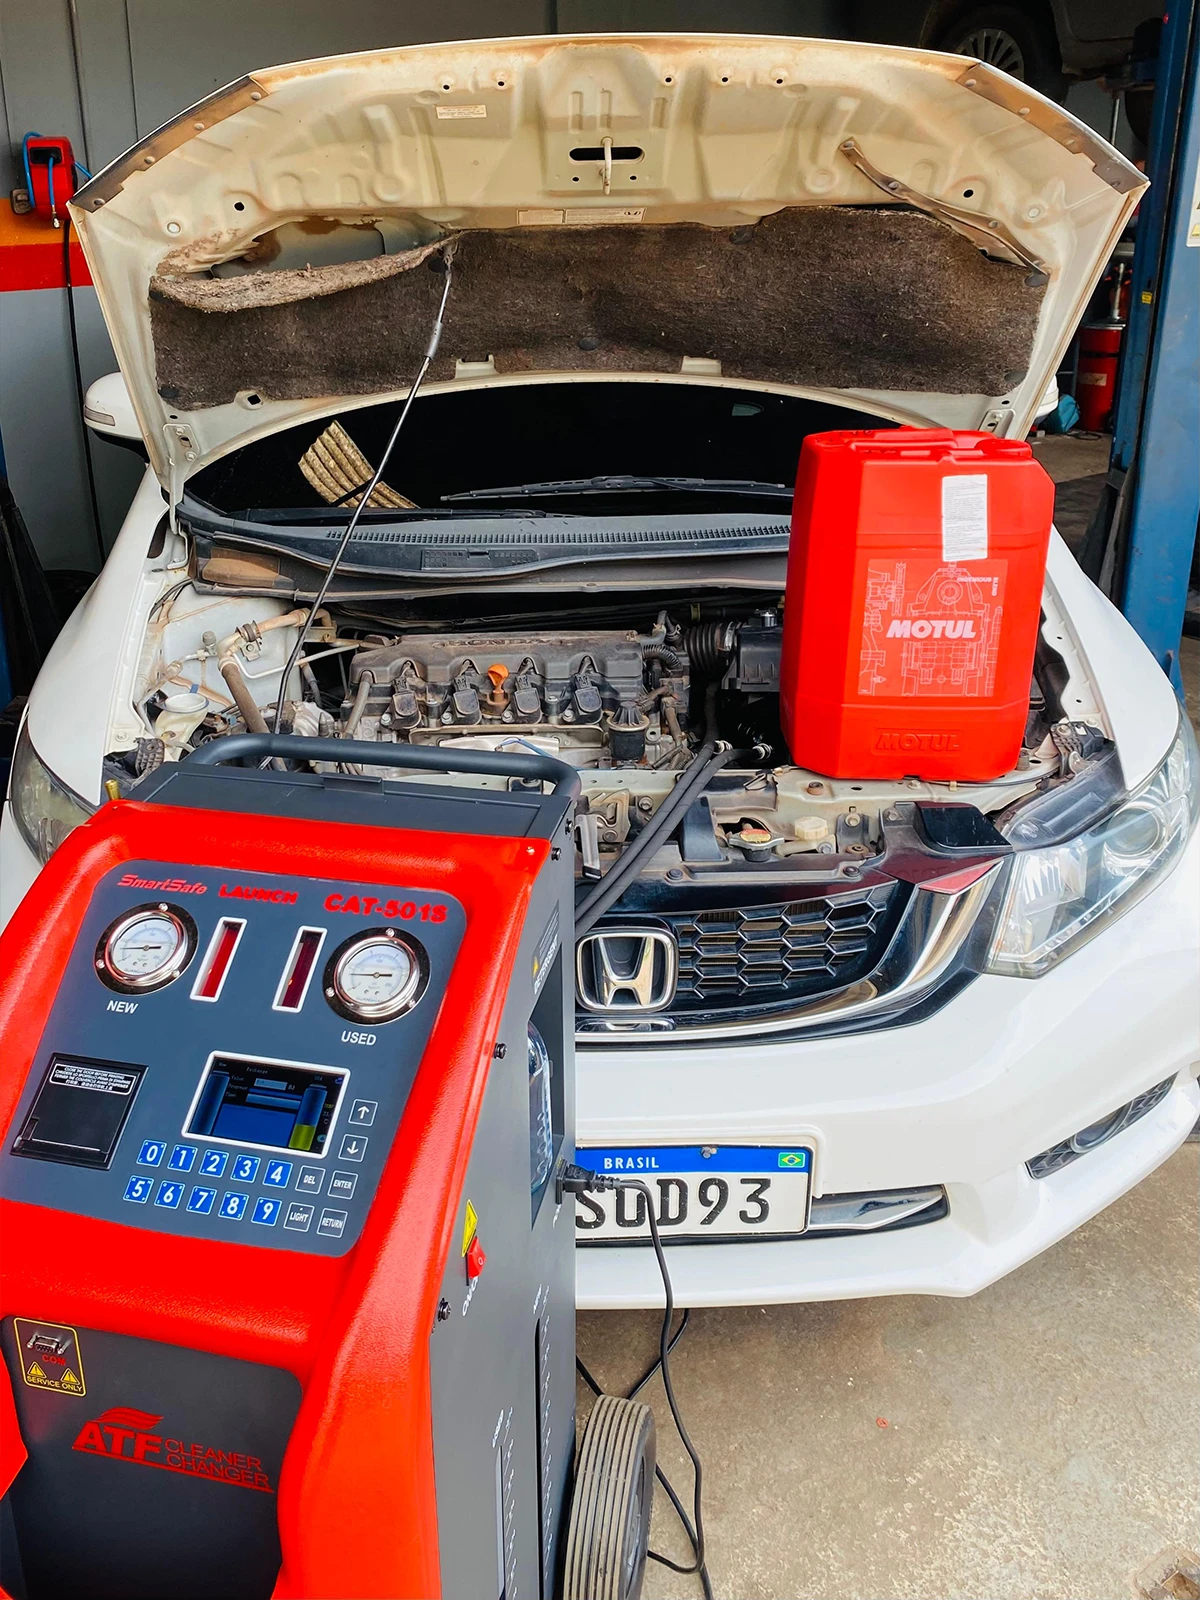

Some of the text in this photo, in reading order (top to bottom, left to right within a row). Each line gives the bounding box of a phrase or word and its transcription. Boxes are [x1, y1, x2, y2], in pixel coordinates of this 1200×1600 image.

[886, 620, 977, 639] MOTUL
[875, 733, 960, 752] MOTUL
[117, 874, 208, 895] SmartSafe
[218, 884, 299, 905] LAUNCH
[323, 893, 448, 924] CAT-501S
[106, 1000, 139, 1014] NEW
[341, 1030, 377, 1047] USED
[146, 1145, 158, 1162] 0
[178, 1150, 187, 1167] 1
[207, 1155, 220, 1172] 2
[240, 1160, 252, 1177] 3
[604, 1157, 660, 1170] BRASIL
[271, 1165, 283, 1183] 4
[303, 1174, 316, 1185] DEL
[132, 1180, 145, 1197] 5
[333, 1179, 352, 1190] ENTER
[163, 1186, 175, 1203] 6
[196, 1191, 208, 1209] 7
[227, 1197, 239, 1215] 8
[262, 1202, 274, 1220] 9
[289, 1211, 309, 1223] LIGHT
[322, 1217, 343, 1229] RETURN
[42, 1354, 66, 1366] COM
[26, 1375, 83, 1392] SERVICE ONLY
[73, 1421, 262, 1472] ATF CLEANER
[166, 1454, 270, 1488] CHANGER
